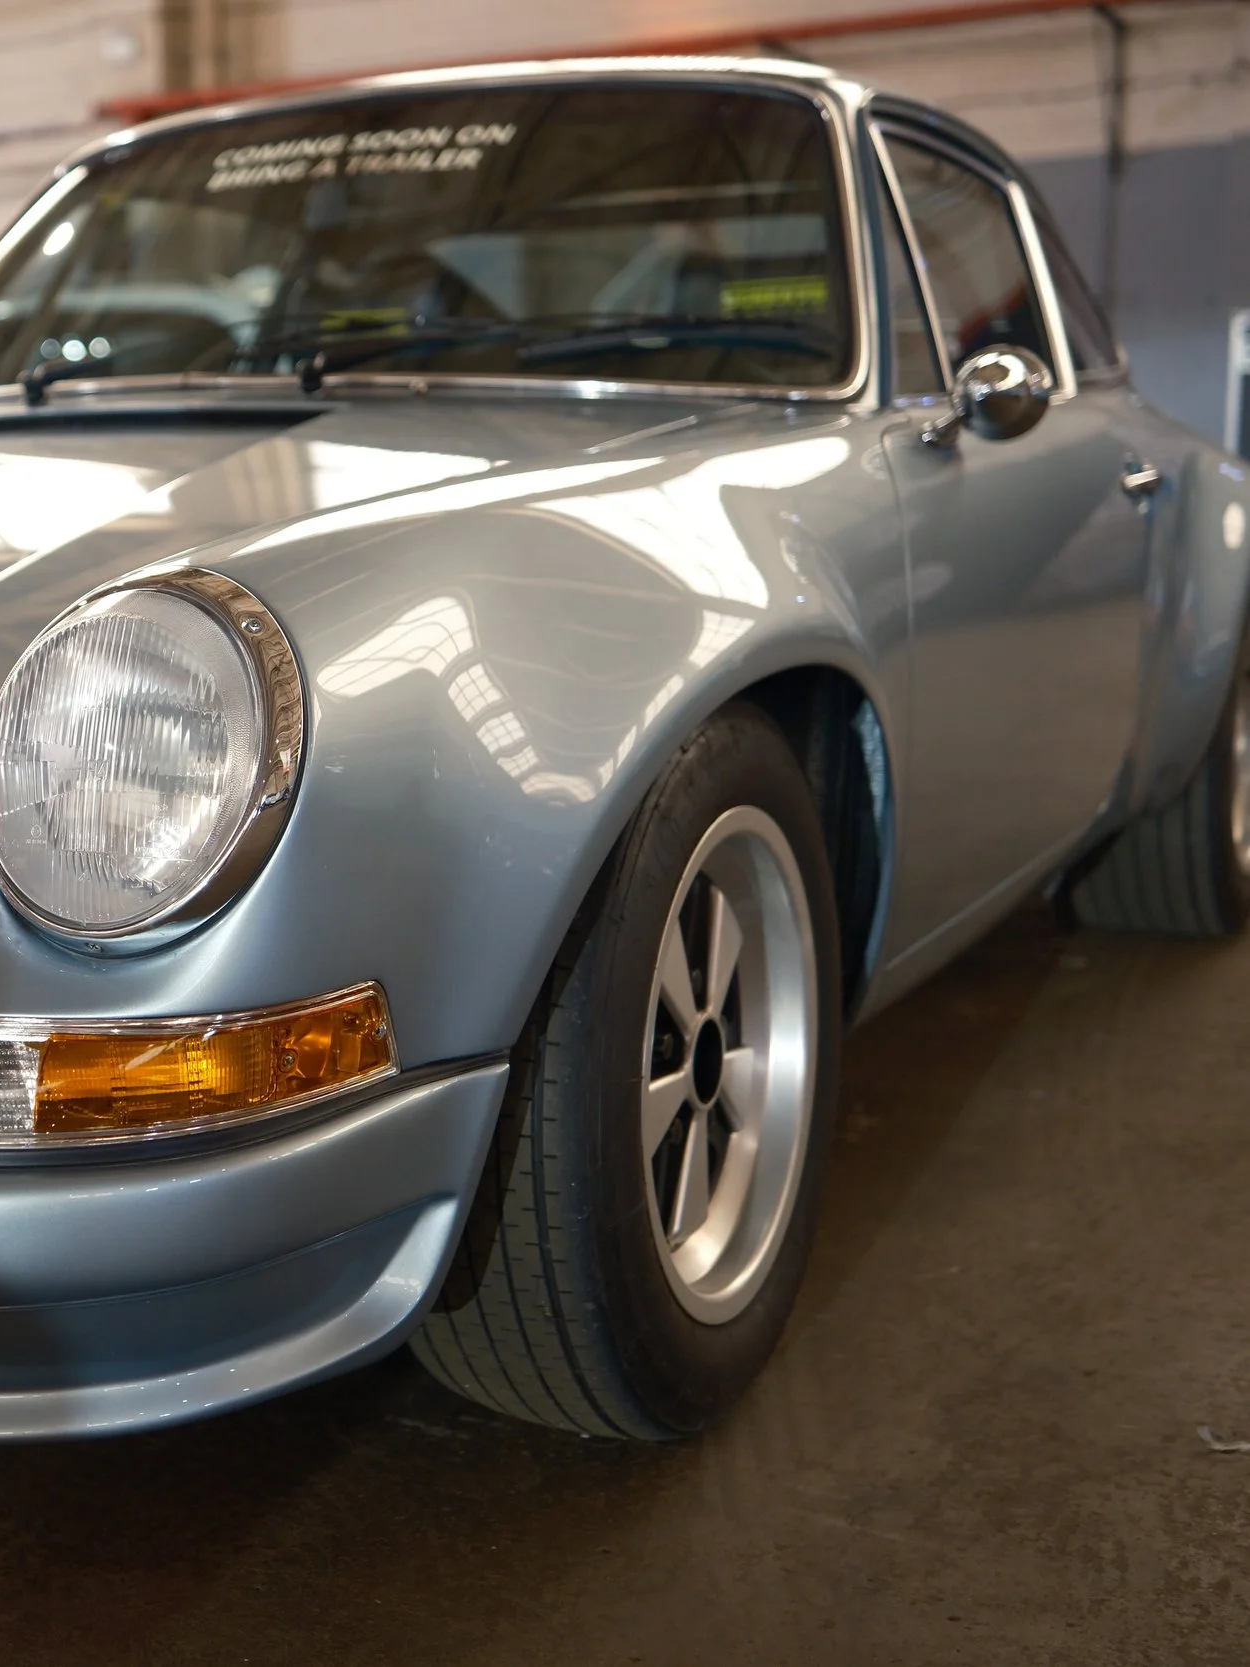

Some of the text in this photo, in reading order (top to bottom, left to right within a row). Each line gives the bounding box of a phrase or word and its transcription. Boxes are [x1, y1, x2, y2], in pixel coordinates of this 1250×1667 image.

[213, 122, 517, 170] COMING SOON ON
[206, 148, 483, 192] BRING A TRAILER
